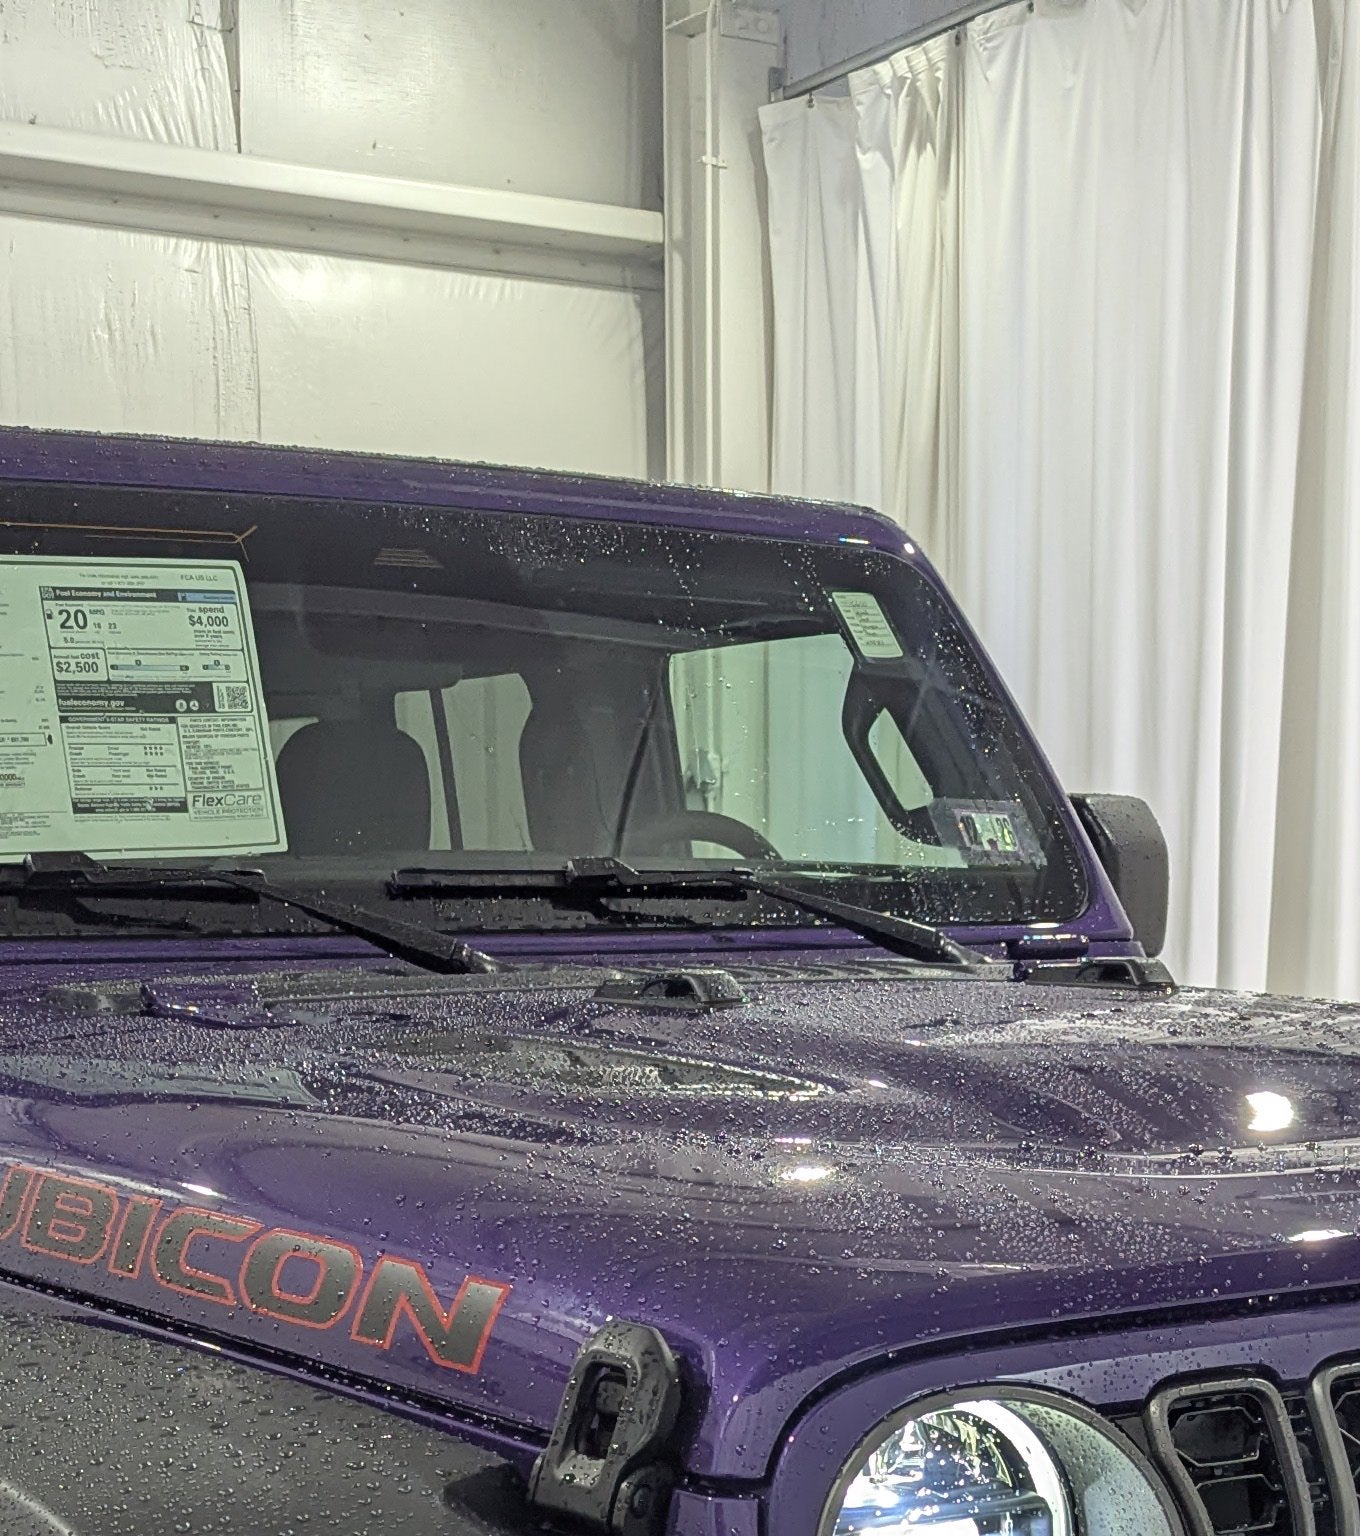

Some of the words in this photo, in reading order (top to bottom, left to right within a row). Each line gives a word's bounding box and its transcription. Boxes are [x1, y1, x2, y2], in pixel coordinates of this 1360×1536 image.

[198, 606, 225, 615] spend
[58, 608, 88, 630] 20
[188, 614, 229, 628] $4,000
[80, 652, 100, 660] cost
[55, 661, 99, 675] $2,500
[192, 793, 262, 807] FlexCare
